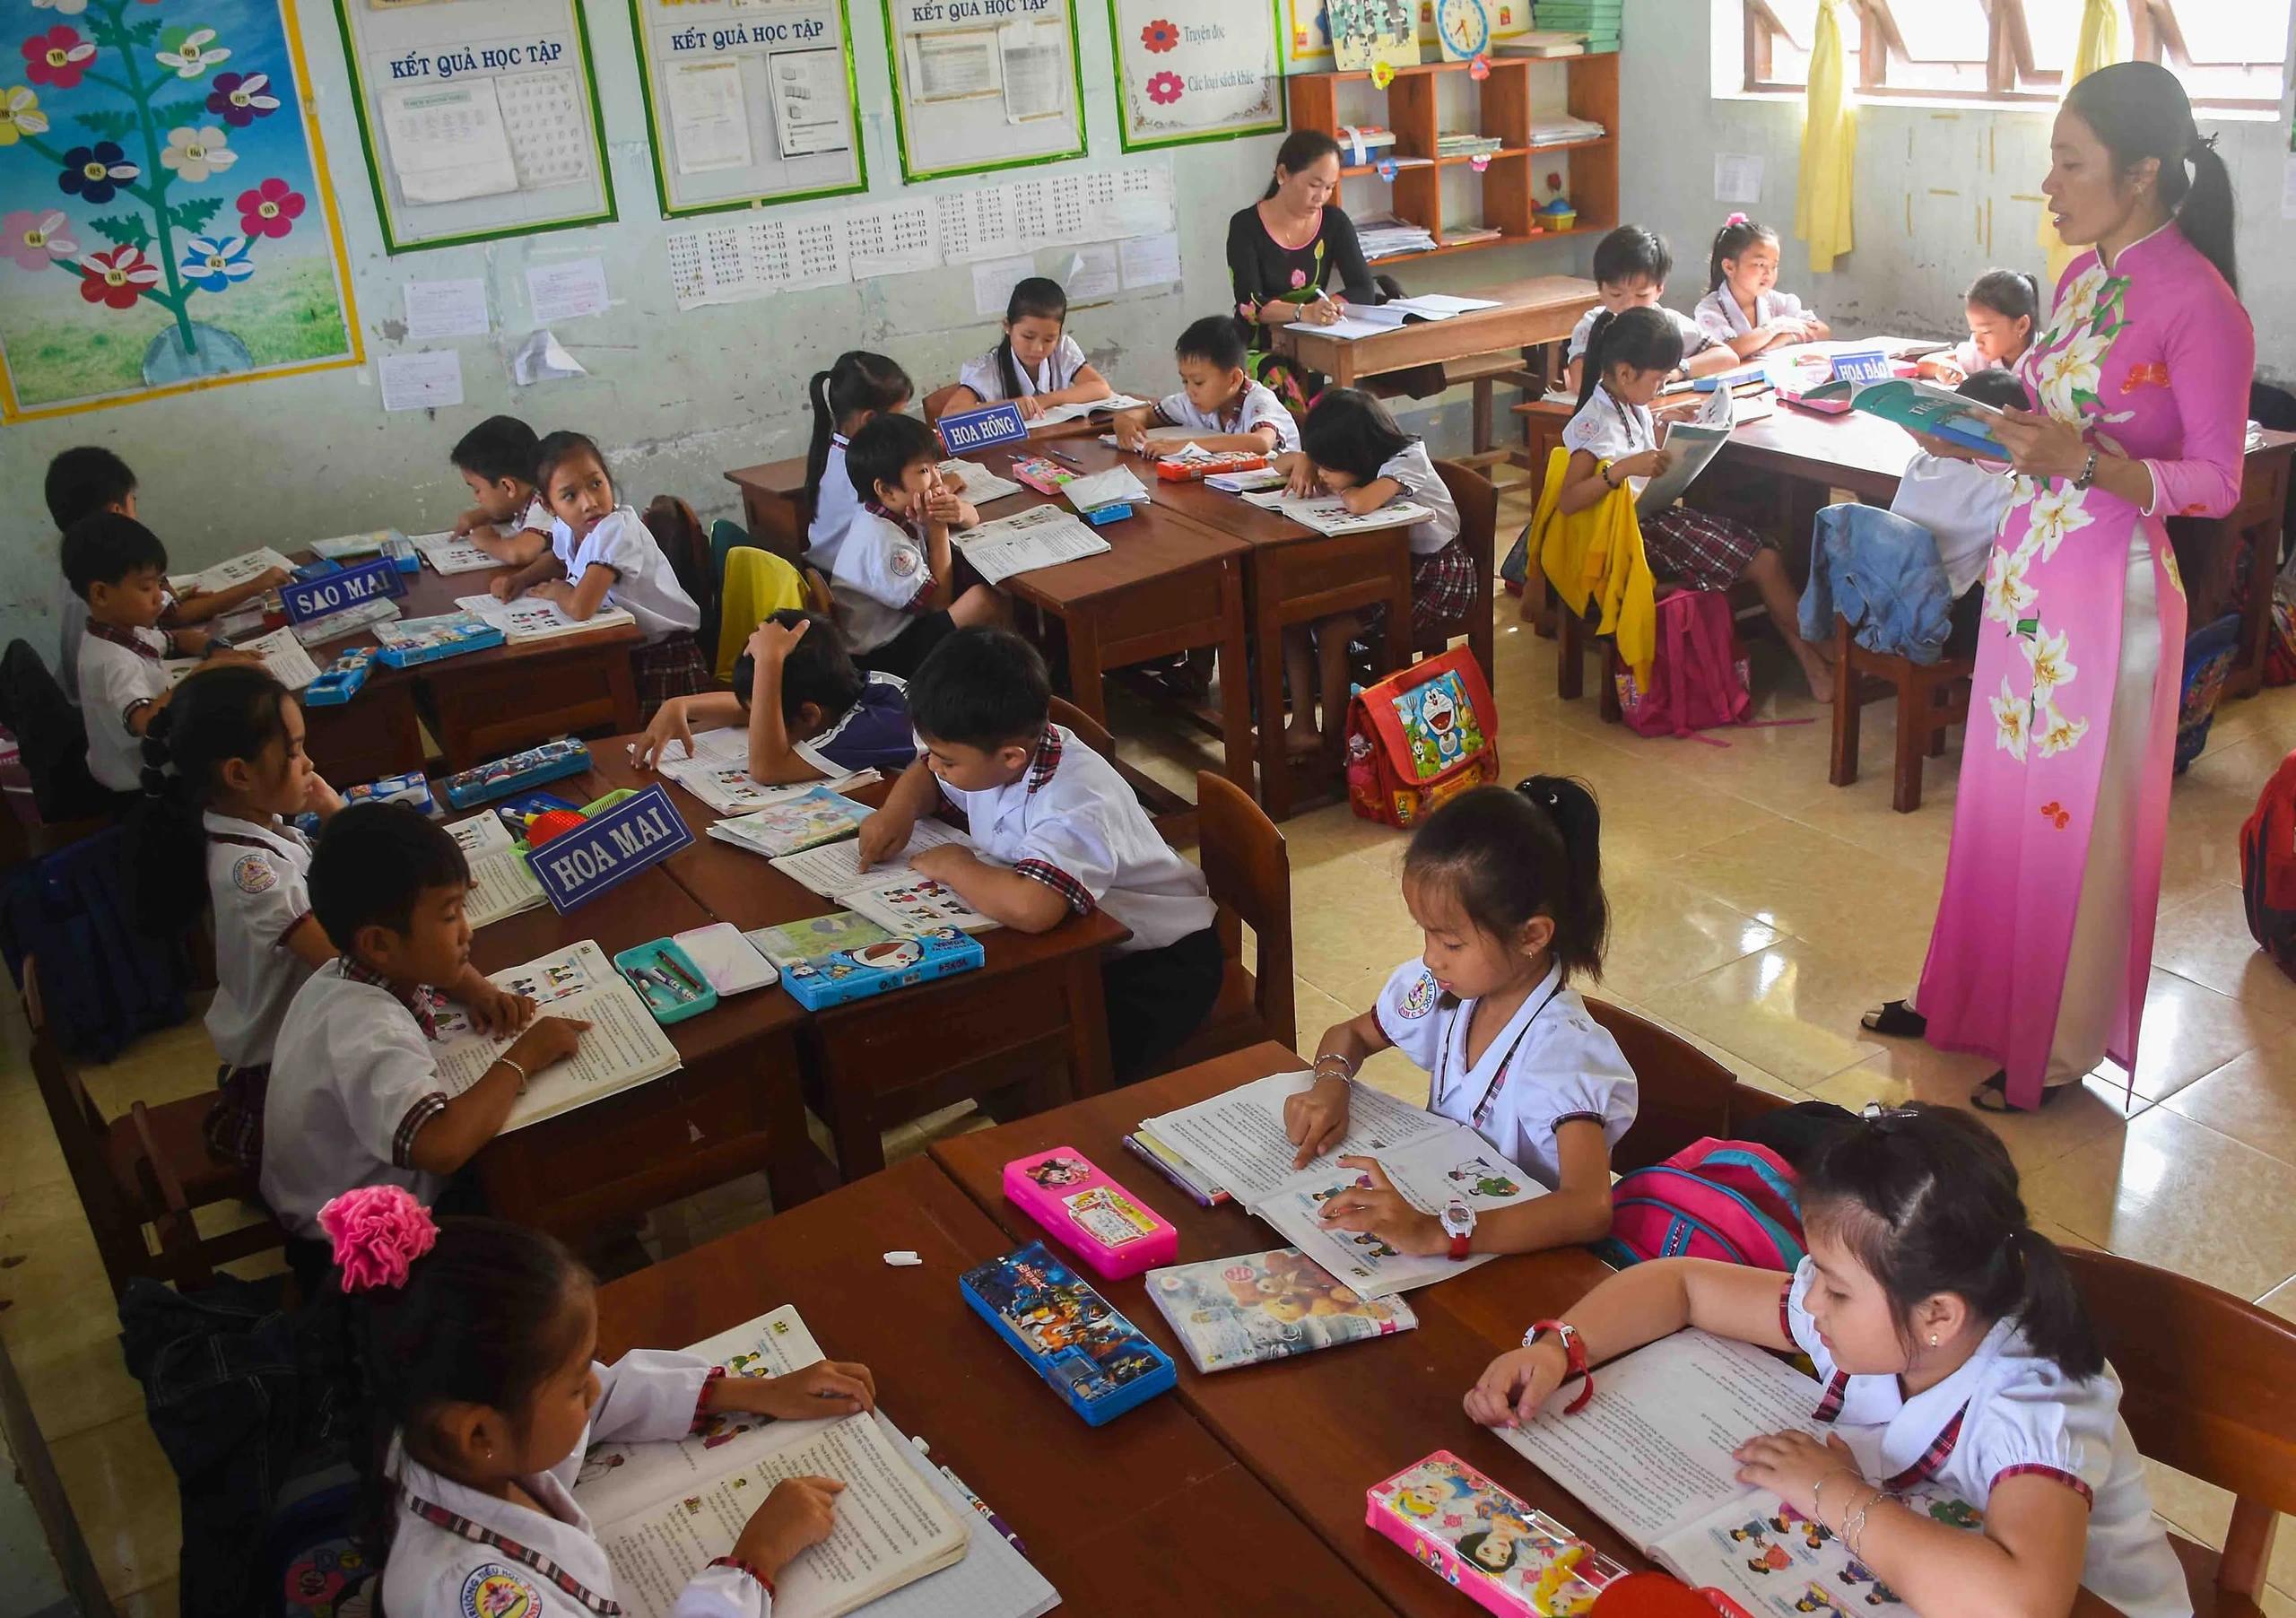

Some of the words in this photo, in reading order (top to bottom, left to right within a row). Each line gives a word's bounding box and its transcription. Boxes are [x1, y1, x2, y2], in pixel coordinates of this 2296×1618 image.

[986, 0, 1015, 17] HỌC
[672, 26, 707, 50] KẾT
[713, 23, 748, 50] QUẢ
[752, 26, 788, 45] HỌC
[793, 19, 824, 40] TẬP
[51, 52, 64, 62] 10
[390, 50, 430, 79] KẾT
[437, 46, 477, 78] QUẢ
[481, 49, 522, 70] HỌC
[526, 40, 562, 66] TẬP
[1839, 363, 1866, 380] HOA
[950, 425, 981, 445] HOA
[978, 414, 1015, 438] HỒNG
[297, 586, 340, 614] SAO
[343, 570, 391, 600] MAI
[550, 840, 618, 892] HOA
[609, 807, 672, 859] MAI
